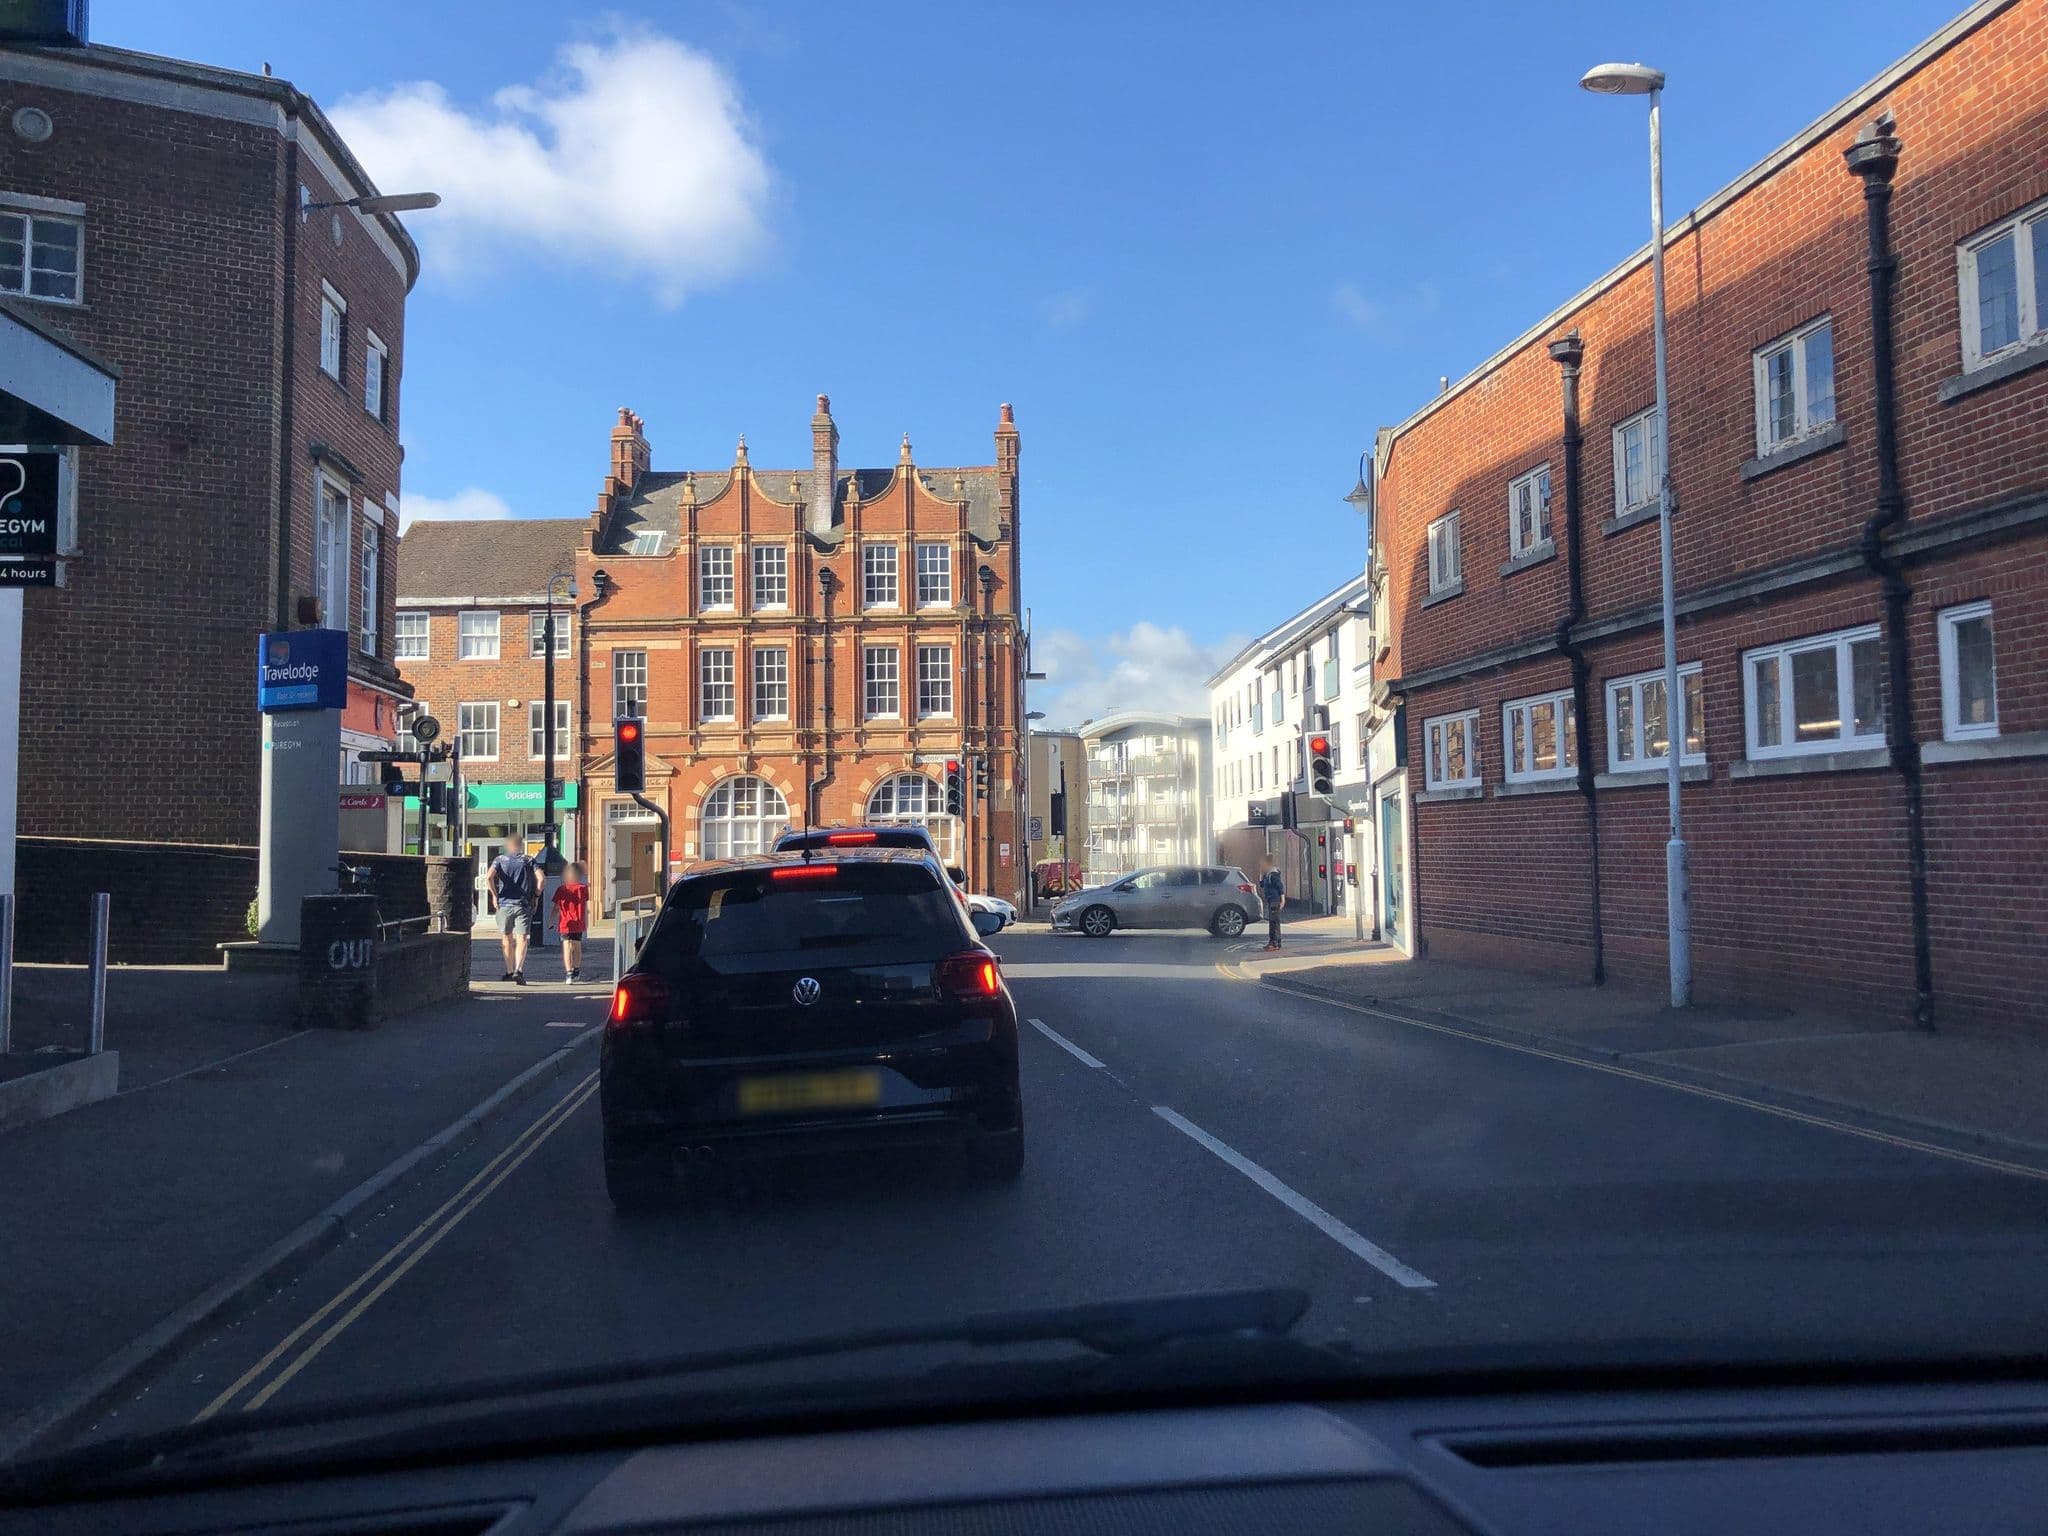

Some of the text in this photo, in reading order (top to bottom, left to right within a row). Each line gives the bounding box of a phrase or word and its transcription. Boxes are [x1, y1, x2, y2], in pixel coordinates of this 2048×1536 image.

[11, 568, 47, 578] hours
[262, 662, 319, 681] Travelodge
[505, 790, 543, 800] Opticians
[329, 939, 372, 969] OUT
